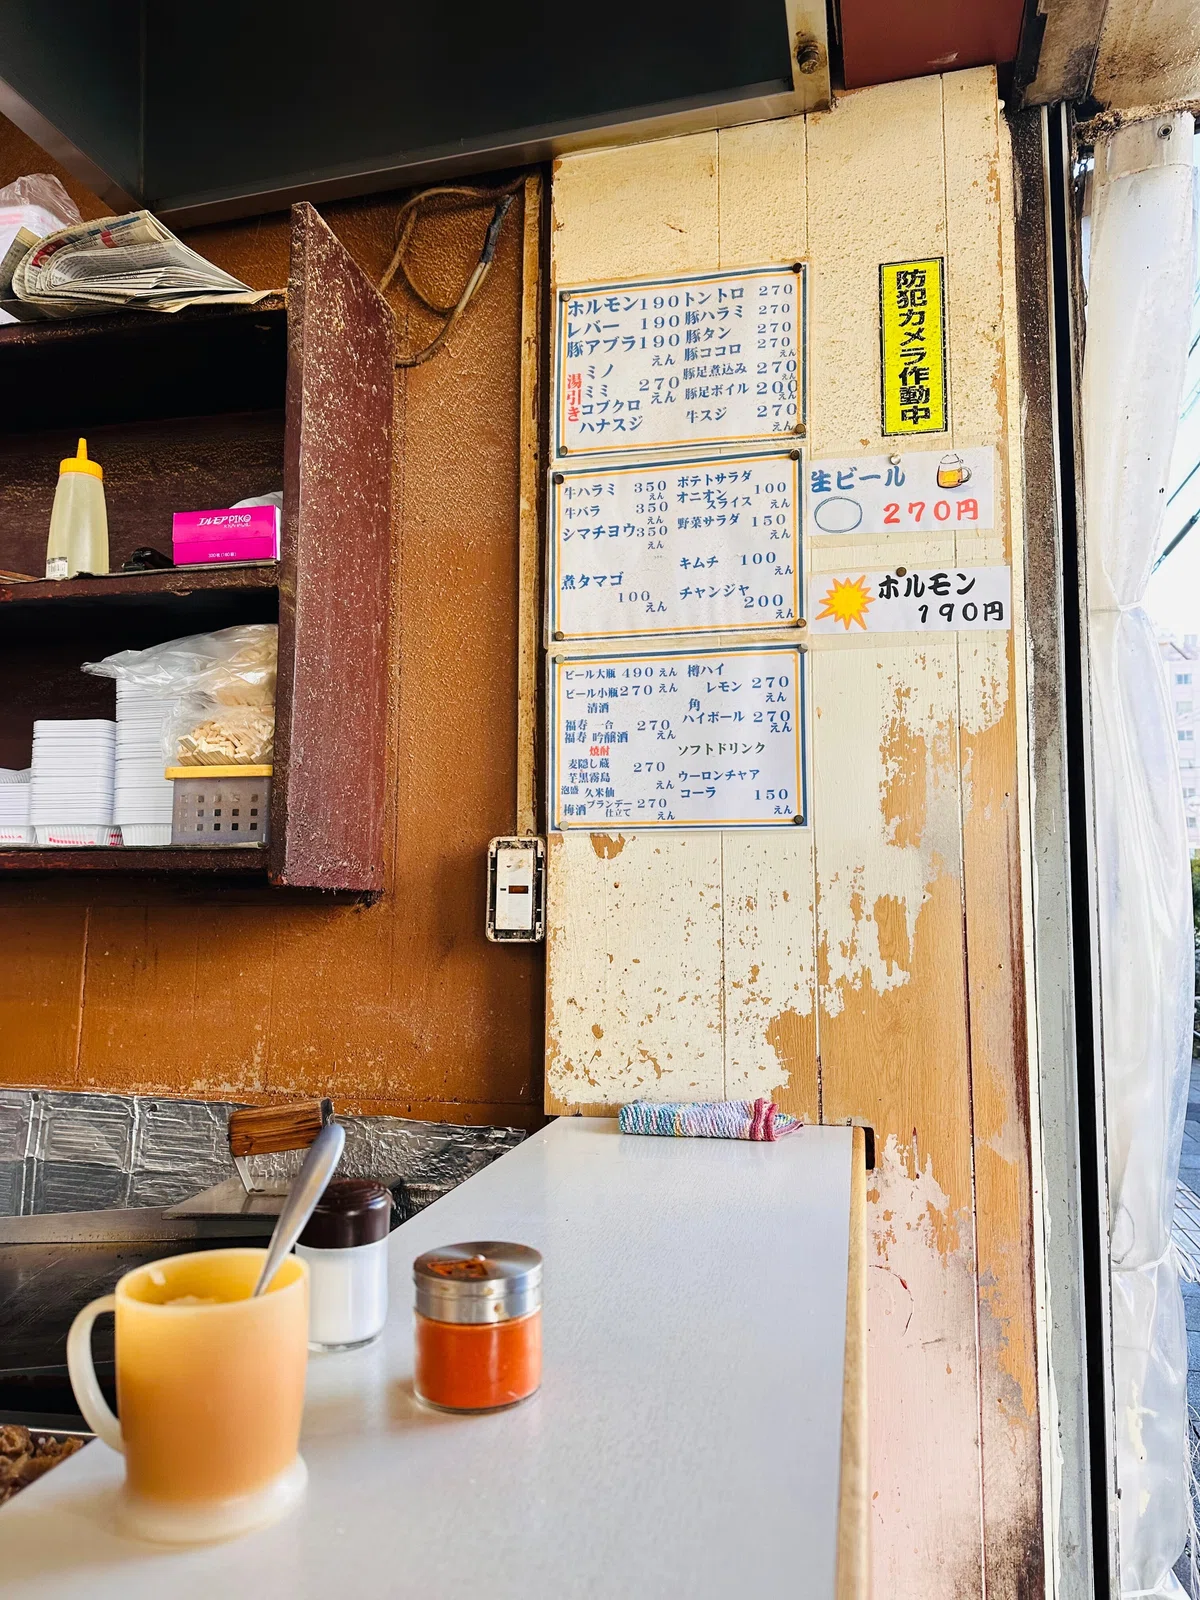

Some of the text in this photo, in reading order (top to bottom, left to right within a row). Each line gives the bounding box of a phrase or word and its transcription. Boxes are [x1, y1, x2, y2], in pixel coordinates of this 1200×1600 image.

[686, 284, 792, 307] トントロ 270
[568, 296, 679, 317] ホルモン 190
[685, 304, 790, 325] 豚ハラミ 270
[567, 316, 679, 339] レバー 190
[686, 322, 791, 344] 豚タン 270
[567, 334, 679, 358] 豚アブラ 190
[685, 337, 790, 361] 豚ココロ 270
[780, 349, 796, 357] えん
[896, 269, 930, 425] 防犯カメラ作動中
[652, 354, 675, 366] えん
[587, 364, 613, 379] ミノ
[683, 359, 797, 380] 豚足煮込み 270
[587, 377, 679, 398] ミミ 270
[685, 380, 798, 400] 豚足ボイル 200
[567, 373, 582, 421] 湯引き
[651, 391, 676, 404] えん
[778, 392, 796, 401] えん
[582, 400, 640, 415] コブクロ
[687, 401, 799, 423] 牛スジ 270
[579, 416, 642, 433] ハナスジ
[772, 421, 794, 432] えん
[678, 470, 786, 494] ポテトサラダ 100
[811, 466, 905, 493] 生ビール
[564, 481, 666, 500] 牛ハラミ 350
[677, 489, 727, 506] オニオン
[704, 494, 790, 509] スライス えん
[565, 502, 668, 519] 牛バラ 350
[883, 499, 978, 524] 270円
[197, 516, 228, 526] エルモア
[228, 514, 251, 523] PIKO
[647, 516, 663, 524] えん
[678, 513, 785, 529] 野菜サラダ 150
[637, 526, 667, 537] 350
[770, 529, 790, 539] えん
[648, 541, 663, 549] えん
[680, 552, 776, 569] キムチ 100
[774, 565, 794, 576] えん
[561, 571, 624, 590] 煮タマゴ
[878, 572, 976, 599] ホルモン
[620, 591, 650, 602] 100
[744, 595, 783, 608] 200
[646, 601, 667, 612] えん
[918, 601, 1003, 623] 190円
[776, 608, 796, 621] えん
[566, 668, 677, 680] ビール大瓶 490 えん
[688, 663, 724, 677] 樽ハイ
[566, 683, 678, 699] ビール小瓶 270 えん
[707, 676, 789, 693] レモン 270
[689, 698, 700, 711] 角
[766, 692, 786, 702] えん
[588, 702, 609, 713] 清酒
[683, 710, 790, 725] ハイボール 270
[566, 719, 587, 731] 福寿
[638, 720, 669, 732] 270
[771, 722, 792, 733] えん
[565, 732, 586, 743] 福寿
[657, 730, 676, 739] えん
[590, 746, 609, 756] 焼酎
[679, 742, 765, 756] ソフトドリンク
[634, 762, 665, 772] 270
[562, 786, 614, 797] 泡盛 久米仙
[656, 780, 674, 789] えん
[681, 787, 788, 800] コーラ 150
[564, 799, 666, 816] 梅酒 ブランデー 270
[606, 809, 675, 820] 仕立て えん
[774, 805, 792, 814] えん
